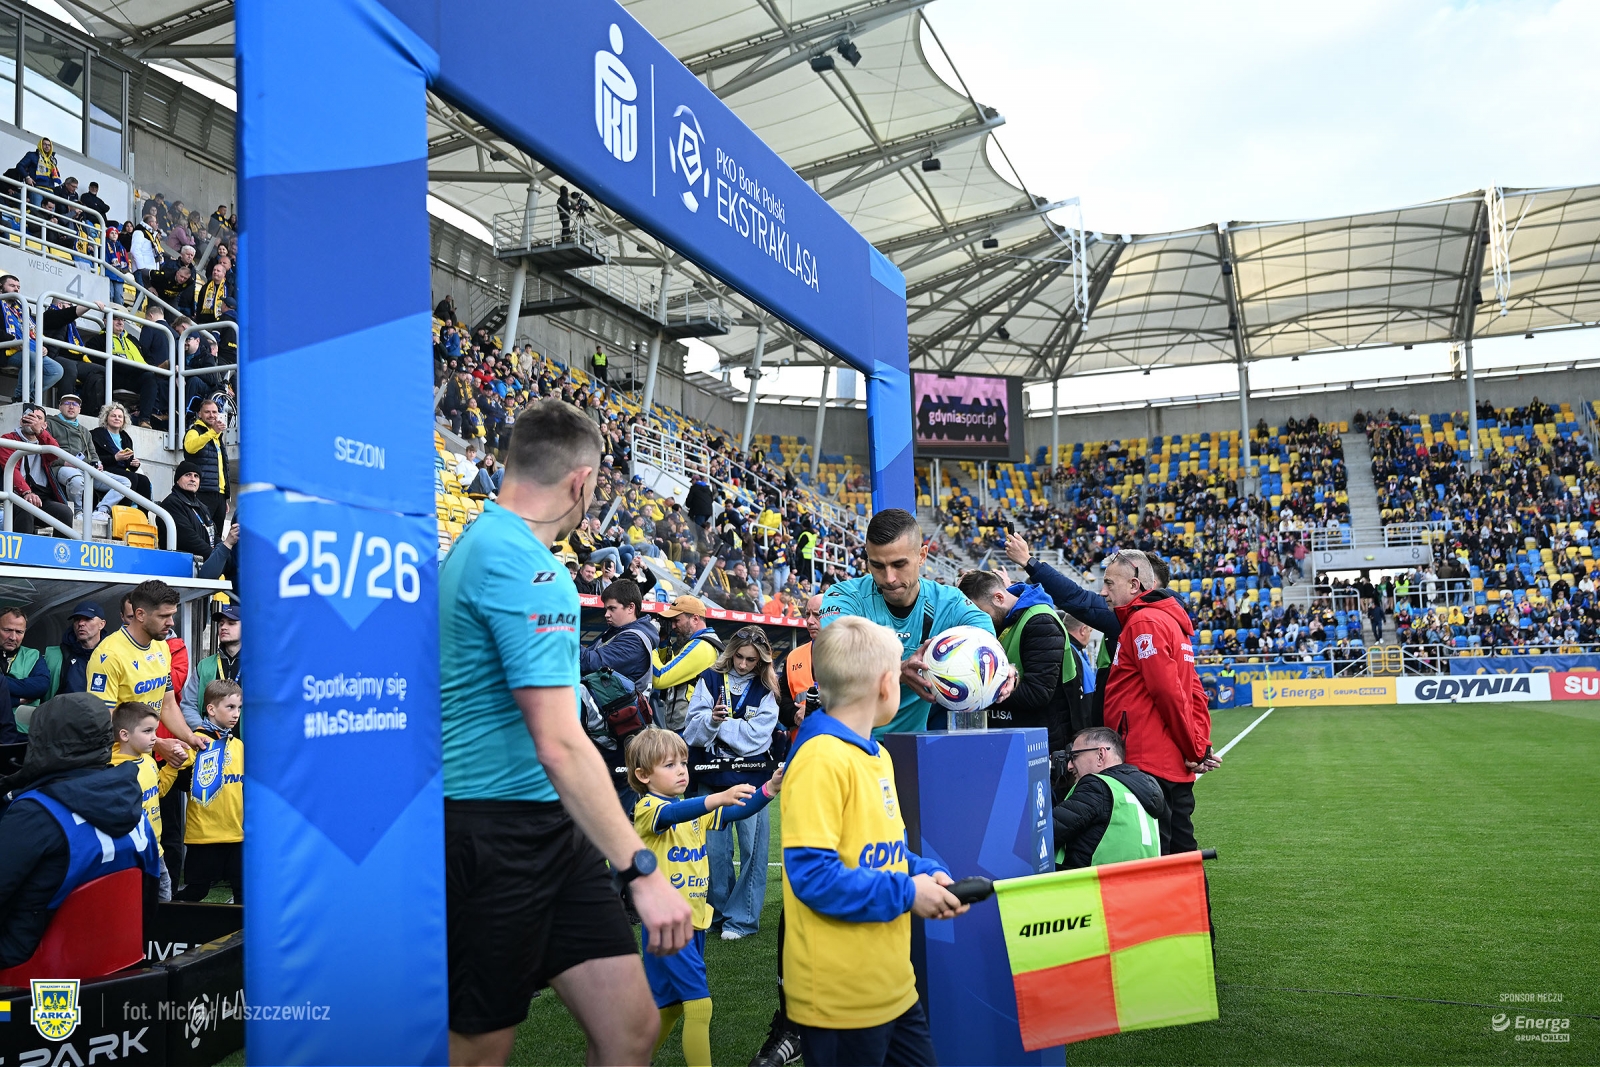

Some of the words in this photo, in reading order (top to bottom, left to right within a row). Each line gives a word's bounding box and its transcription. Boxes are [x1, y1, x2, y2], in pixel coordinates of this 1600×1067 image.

[716, 147, 736, 182] PKO
[739, 166, 761, 202] Bank
[762, 186, 785, 224] Polski
[716, 177, 819, 293] EKSTRAKLASA
[27, 258, 63, 277] WEJŚCIE
[65, 273, 84, 299] 4
[928, 408, 997, 428] gdyniasport.pl
[333, 436, 386, 470] SEZON
[80, 543, 114, 569] 2018
[278, 529, 421, 604] 25/26
[1323, 552, 1333, 564] D
[1411, 547, 1420, 559] 8
[792, 662, 803, 671] 106
[302, 672, 384, 706] Spotkajmy
[386, 672, 408, 701] się
[1281, 687, 1325, 699] Energa
[1359, 687, 1387, 695] ORLEN
[1414, 677, 1531, 701] GDYNIA
[1564, 675, 1600, 695] SU
[304, 707, 408, 739] #NaStadionie
[1019, 913, 1092, 938] 4MOVE
[143, 940, 188, 961] IVE
